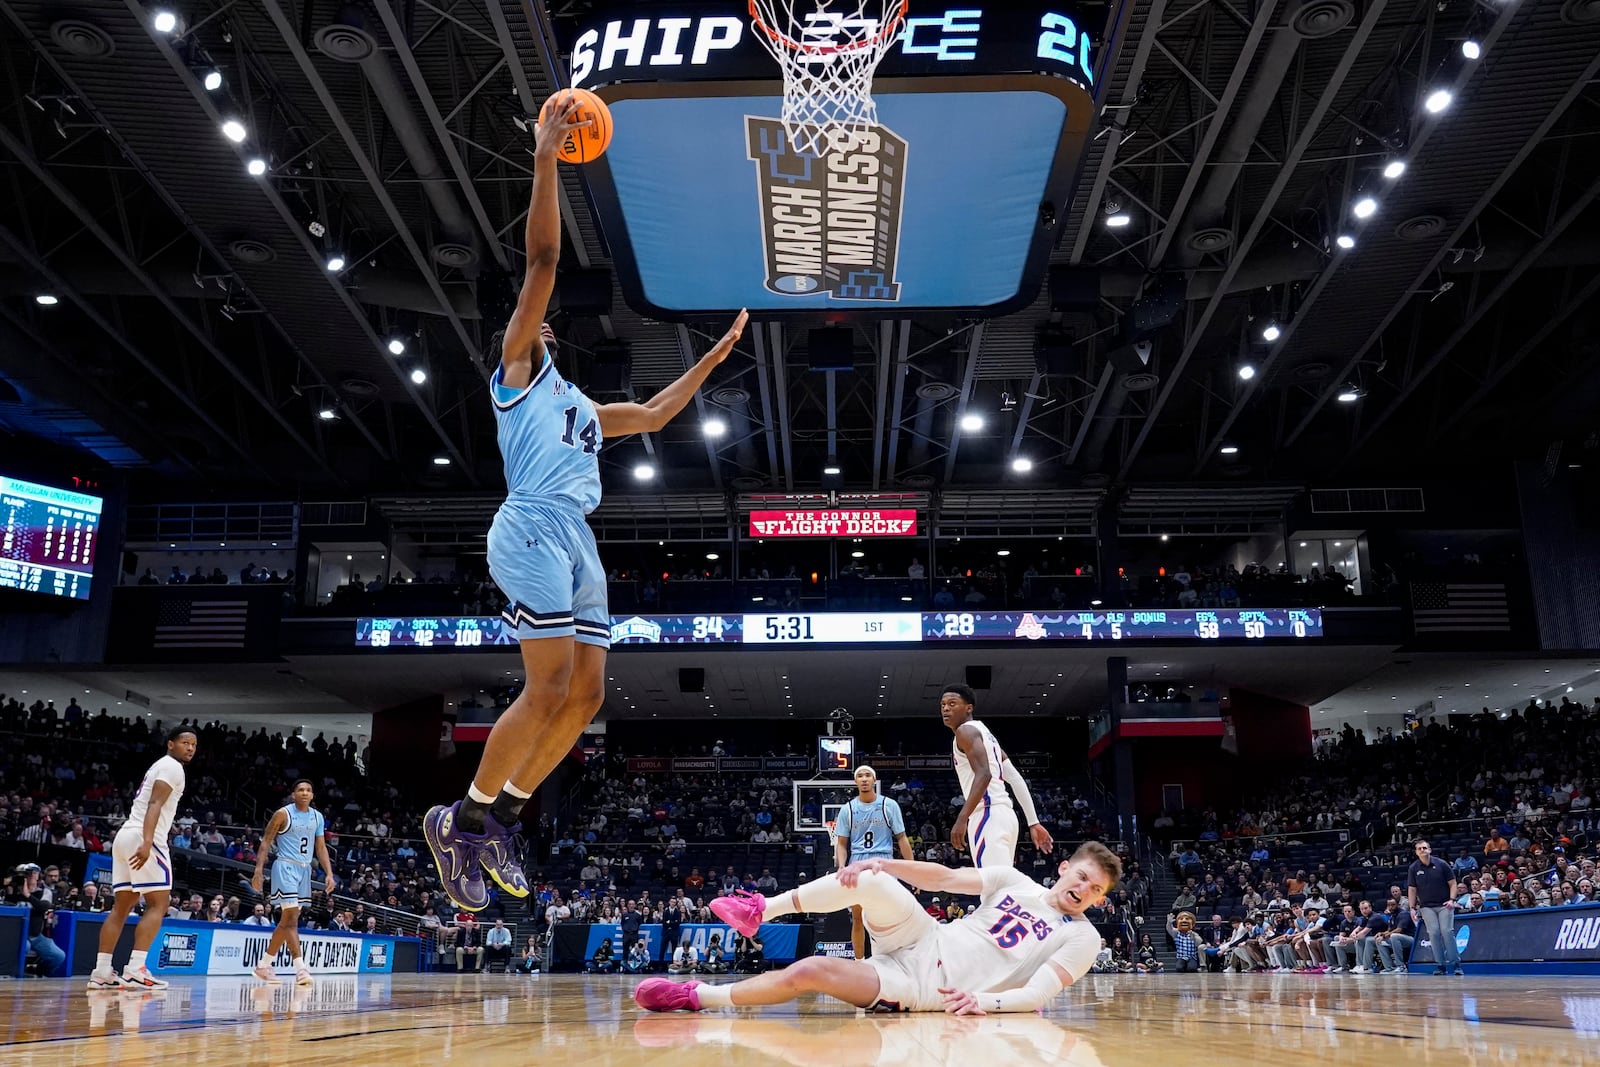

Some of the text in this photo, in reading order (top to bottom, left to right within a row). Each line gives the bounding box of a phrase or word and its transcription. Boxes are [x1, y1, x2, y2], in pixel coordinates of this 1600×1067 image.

[571, 17, 743, 89] SHIP
[827, 128, 880, 265] MADNESS
[771, 185, 822, 275] MARCH
[560, 405, 598, 455] 14
[786, 512, 881, 521] THE CONNOR
[765, 520, 902, 535] FLIGHT DECK
[372, 619, 392, 630] FG%
[412, 619, 438, 630] 3PT%
[458, 619, 478, 630] FT%
[945, 613, 974, 636] 28
[1078, 613, 1098, 623] TOL
[1133, 612, 1166, 623] BONUS
[1239, 611, 1266, 621] 3PT%
[692, 616, 723, 639] 34
[766, 616, 814, 640] 5:31
[864, 622, 884, 632] 1ST
[1082, 624, 1093, 640] 4
[1111, 623, 1122, 639] 5
[1199, 621, 1219, 638] 58
[1244, 621, 1265, 638] 50
[1295, 621, 1305, 637] 0
[371, 629, 391, 647] 59
[414, 629, 434, 647] 42
[455, 629, 481, 647] 100
[637, 761, 662, 769] LOYOLA
[300, 837, 309, 854] 2
[863, 831, 875, 849] 8
[995, 894, 1053, 941] EAGLES
[987, 912, 1029, 948] 15
[1555, 917, 1600, 951] ROAD
[309, 941, 323, 968] OF
[323, 942, 358, 968] DAYTON
[823, 943, 846, 951] MARCH
[826, 950, 856, 958] MADNESS
